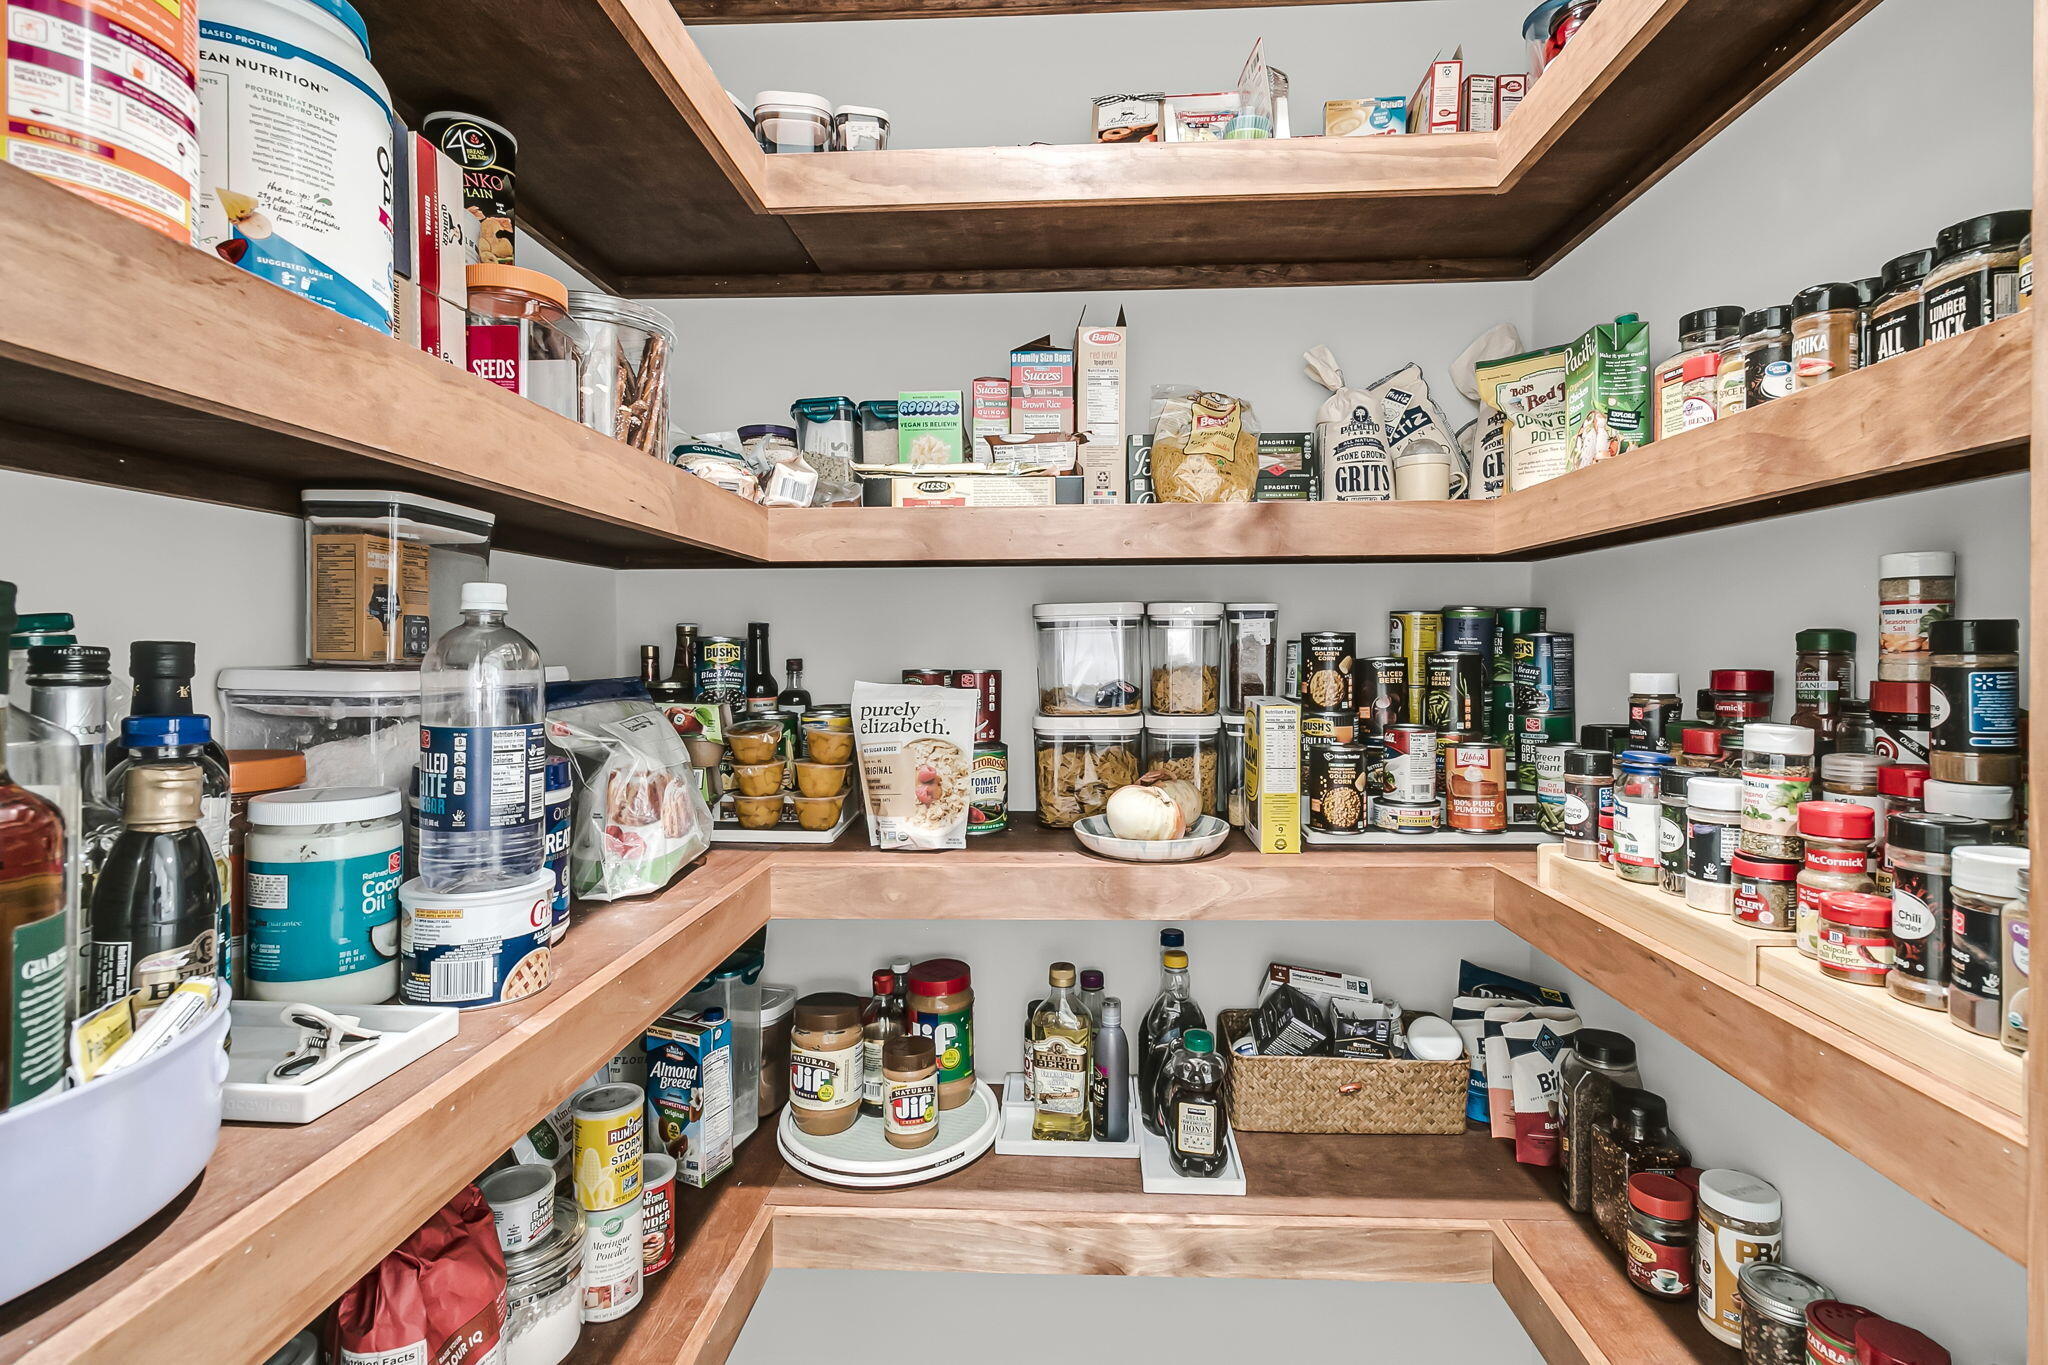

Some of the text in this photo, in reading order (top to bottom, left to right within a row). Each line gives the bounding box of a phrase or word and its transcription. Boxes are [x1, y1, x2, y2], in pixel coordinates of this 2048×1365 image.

[235, 34, 278, 52] PROTEIN
[200, 50, 230, 65] EAN
[446, 128, 486, 164] 4C
[464, 172, 504, 191] NKO
[440, 204, 448, 246] QUAKER
[256, 256, 334, 281] SUGGESTED USAGE
[1930, 296, 1966, 324] LUMBER
[1931, 313, 1966, 344] JACK
[1092, 332, 1120, 342] Barilla
[1878, 326, 1905, 358] ALL
[1792, 334, 1828, 358] PRIKA
[1018, 354, 1039, 364] Family
[1040, 353, 1053, 363] Size
[1054, 354, 1071, 363] Bags
[1565, 334, 1597, 375] Pacific
[472, 359, 516, 380] SEEDS
[1024, 370, 1061, 380] Success
[976, 384, 1008, 395] Success
[1510, 384, 1534, 398] Bob's
[1569, 386, 1588, 404] Chicken
[1022, 400, 1062, 408] Brown Rice
[1526, 387, 1556, 412] Red
[900, 401, 958, 414] GOODLES
[1569, 402, 1585, 416] Stock
[1516, 412, 1552, 428] CORN
[1340, 424, 1380, 435] PALMETTO
[692, 445, 737, 458] QUINOA
[1336, 450, 1386, 462] STONE GROUND
[1335, 464, 1390, 493] GRITS
[920, 482, 950, 490] ALESSI
[1884, 618, 1919, 626] Seasoned
[706, 648, 740, 658] BUSH'S
[702, 670, 744, 679] Black Beans
[1518, 666, 1540, 676] Beans
[860, 702, 920, 720] purely
[860, 718, 950, 736] elizabeth.
[1303, 722, 1332, 732] BUSH'S
[1460, 752, 1486, 763] Libby's
[1521, 754, 1536, 762] BEA
[1536, 752, 1561, 762] Green
[1536, 762, 1562, 772] Giant
[420, 774, 448, 798] HITE
[971, 776, 1000, 787] TOMATO
[976, 786, 998, 795] PUREE
[1454, 806, 1494, 814] PUMPKIN
[1472, 800, 1496, 808] PURE
[1663, 832, 1676, 842] Bay
[1808, 852, 1864, 868] McCormick
[362, 869, 388, 880] Refined
[362, 895, 386, 914] Oil
[1734, 898, 1765, 911] CELERY
[1898, 909, 1922, 924] Chili
[1822, 944, 1853, 956] Chipotle
[1831, 952, 1860, 964] Pepper
[793, 1056, 831, 1068] NATURAL
[1036, 1060, 1080, 1070] BERIO
[1040, 1054, 1078, 1064] FILIPPO
[650, 1060, 698, 1081] Almond
[660, 1076, 692, 1090] Breeze
[793, 1065, 830, 1092] Jif
[894, 1086, 932, 1096] NATURAL
[659, 1099, 690, 1112] UNSWEETENED
[896, 1095, 932, 1119] Jif
[664, 1108, 685, 1120] Original
[1183, 1124, 1210, 1134] HONEY
[617, 1135, 642, 1153] CORN
[611, 1146, 643, 1166] STARC
[643, 1200, 670, 1218] KING
[592, 1233, 632, 1252] Meringue
[596, 1246, 630, 1262] Powder
[1735, 1239, 1782, 1264] PB2
[468, 1330, 483, 1348] IQ
[1806, 1334, 1850, 1365] ZATARA
